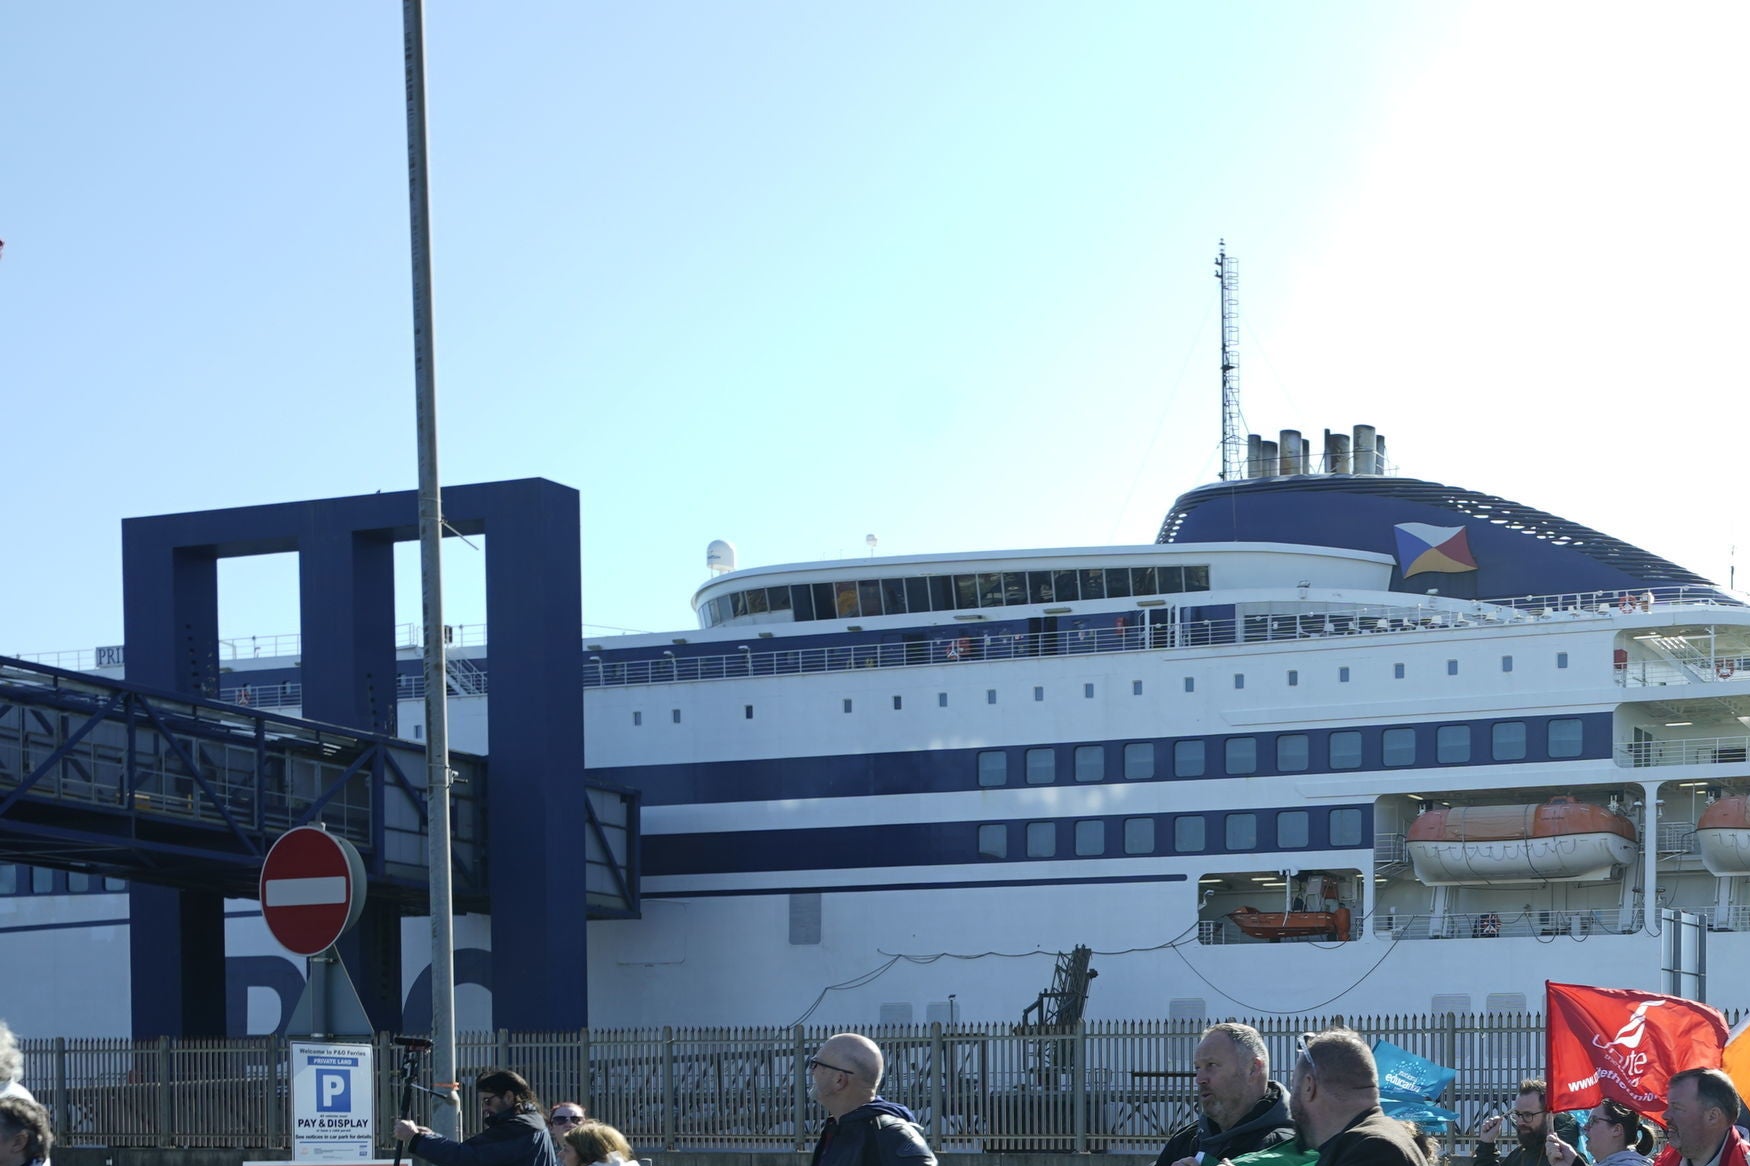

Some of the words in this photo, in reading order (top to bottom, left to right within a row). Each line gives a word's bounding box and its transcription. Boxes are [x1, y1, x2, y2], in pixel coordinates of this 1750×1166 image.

[98, 647, 124, 665] PRI
[322, 1074, 345, 1107] P
[298, 1118, 317, 1128] PAY
[319, 1118, 326, 1128] &
[327, 1118, 369, 1128] DISPLAY
